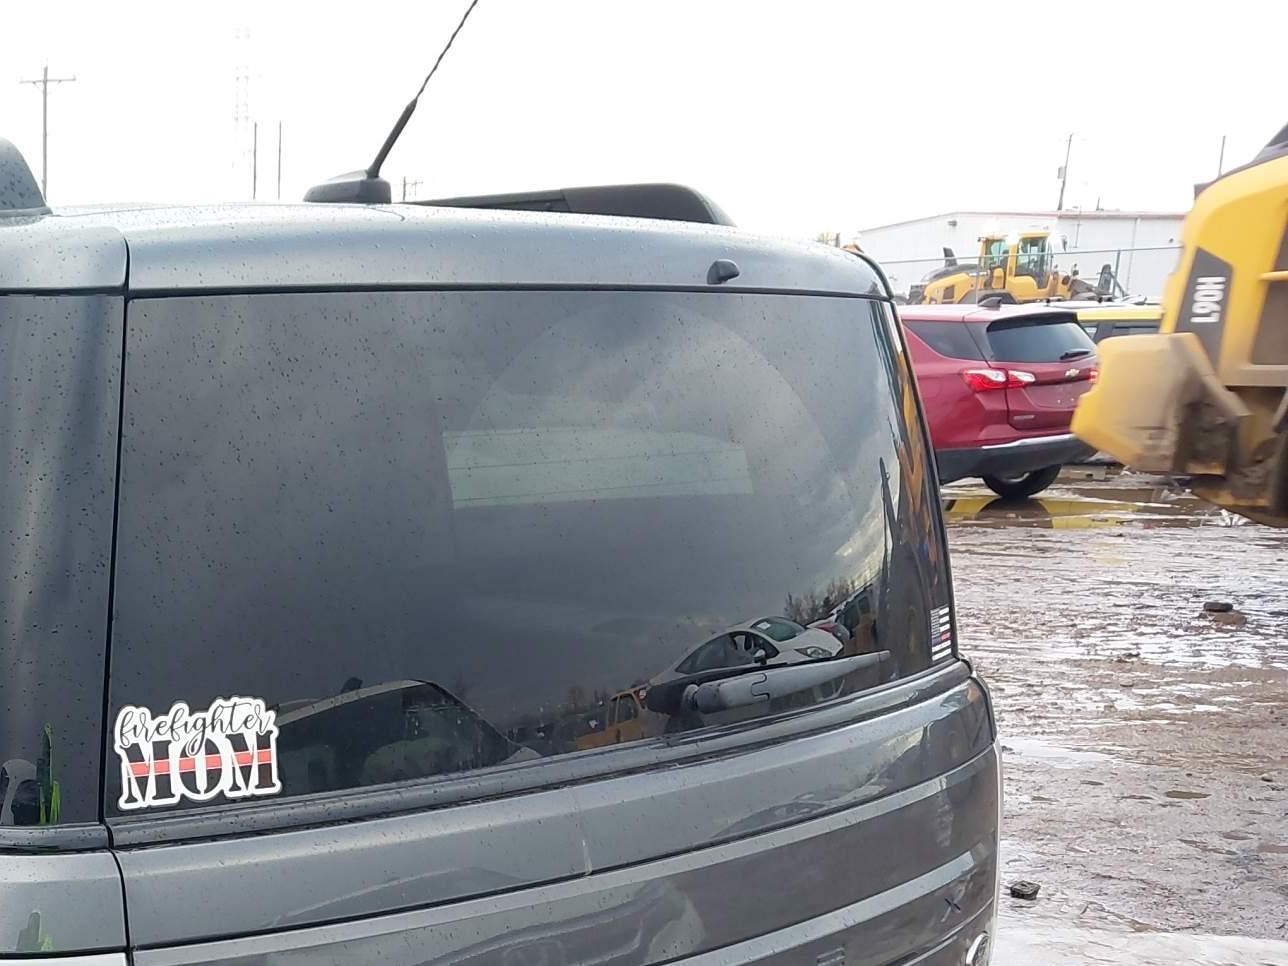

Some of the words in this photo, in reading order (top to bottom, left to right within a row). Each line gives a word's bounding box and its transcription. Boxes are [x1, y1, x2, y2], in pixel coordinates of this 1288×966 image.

[1190, 276, 1227, 323] L90H
[119, 702, 272, 756] firefighter
[119, 730, 277, 804] MOM
